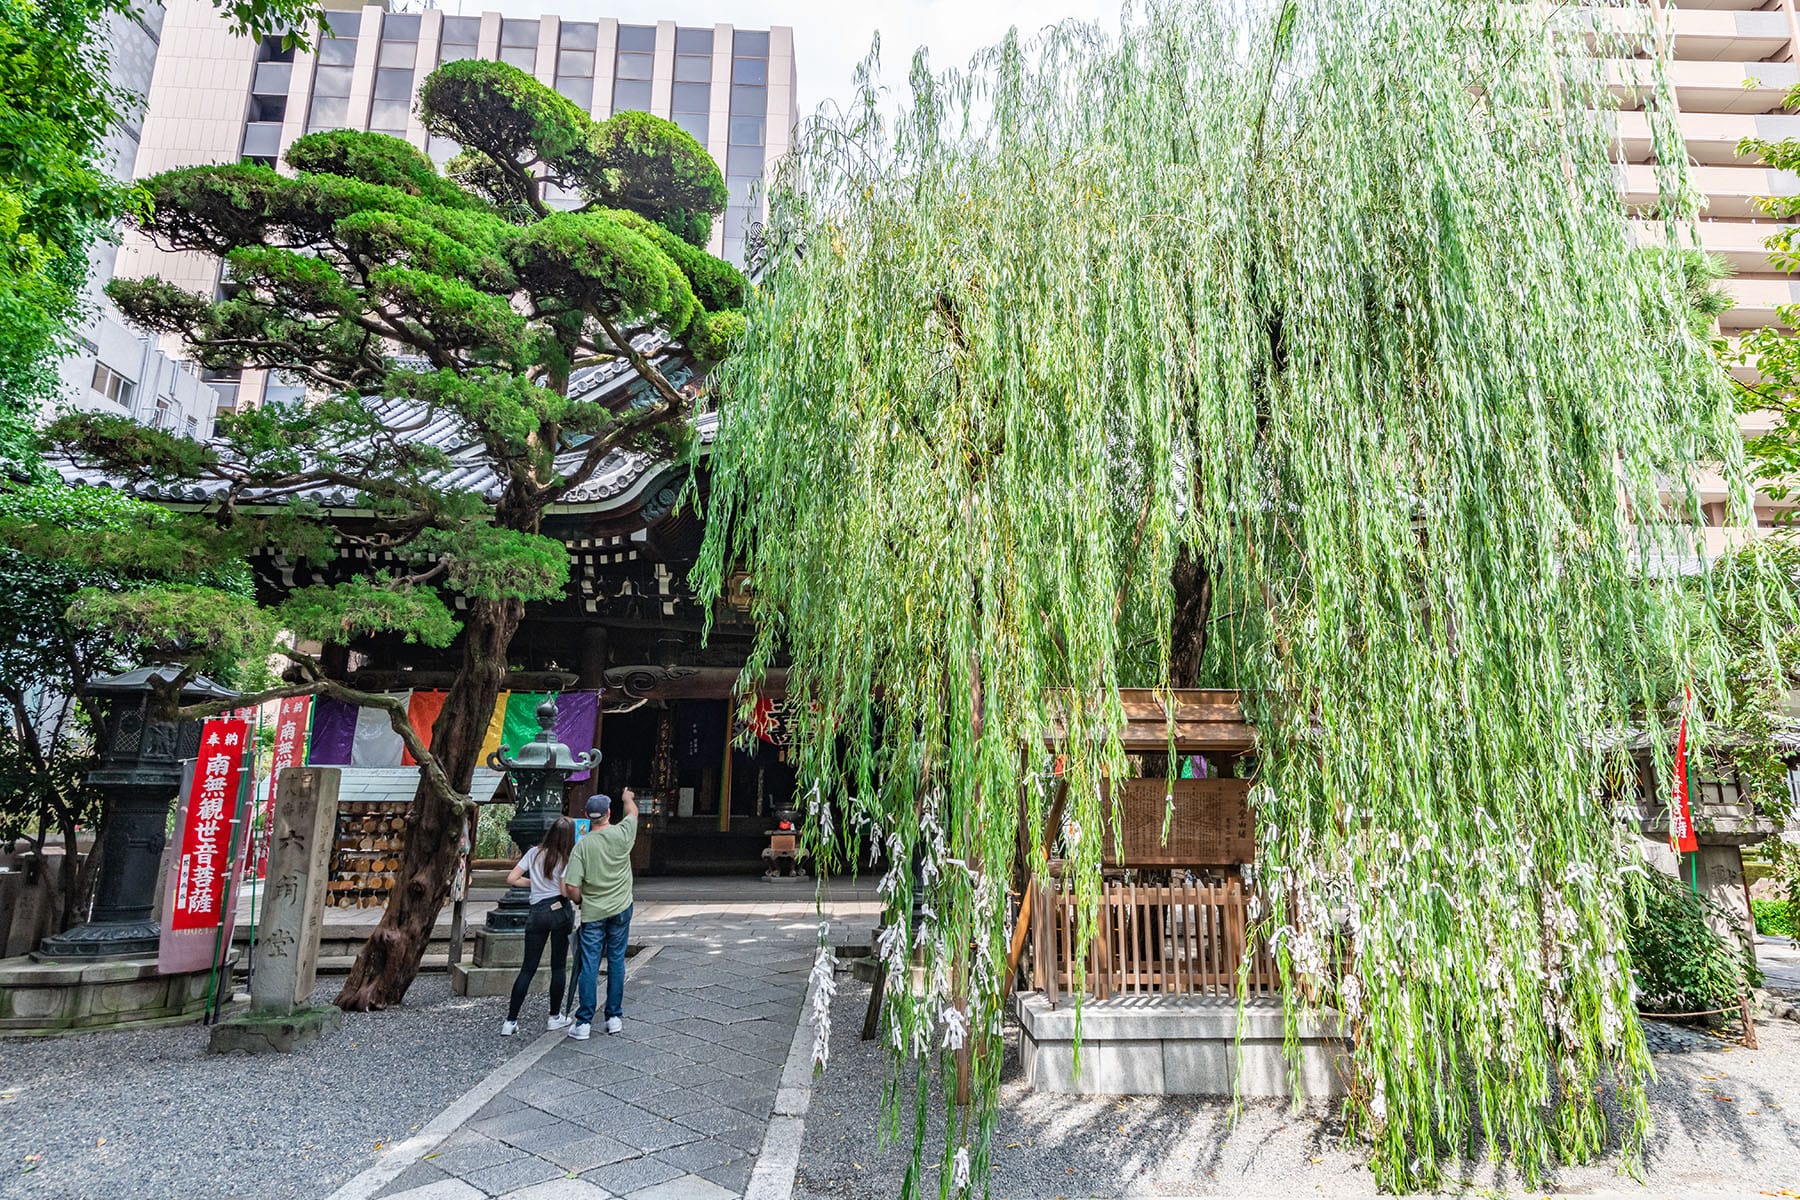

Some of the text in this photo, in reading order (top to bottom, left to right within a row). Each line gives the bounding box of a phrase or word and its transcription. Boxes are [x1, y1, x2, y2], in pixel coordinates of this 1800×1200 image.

[207, 732, 239, 747] 奉納
[188, 753, 228, 914] 南無観世音菩薩
[264, 830, 305, 958] 六角堂
